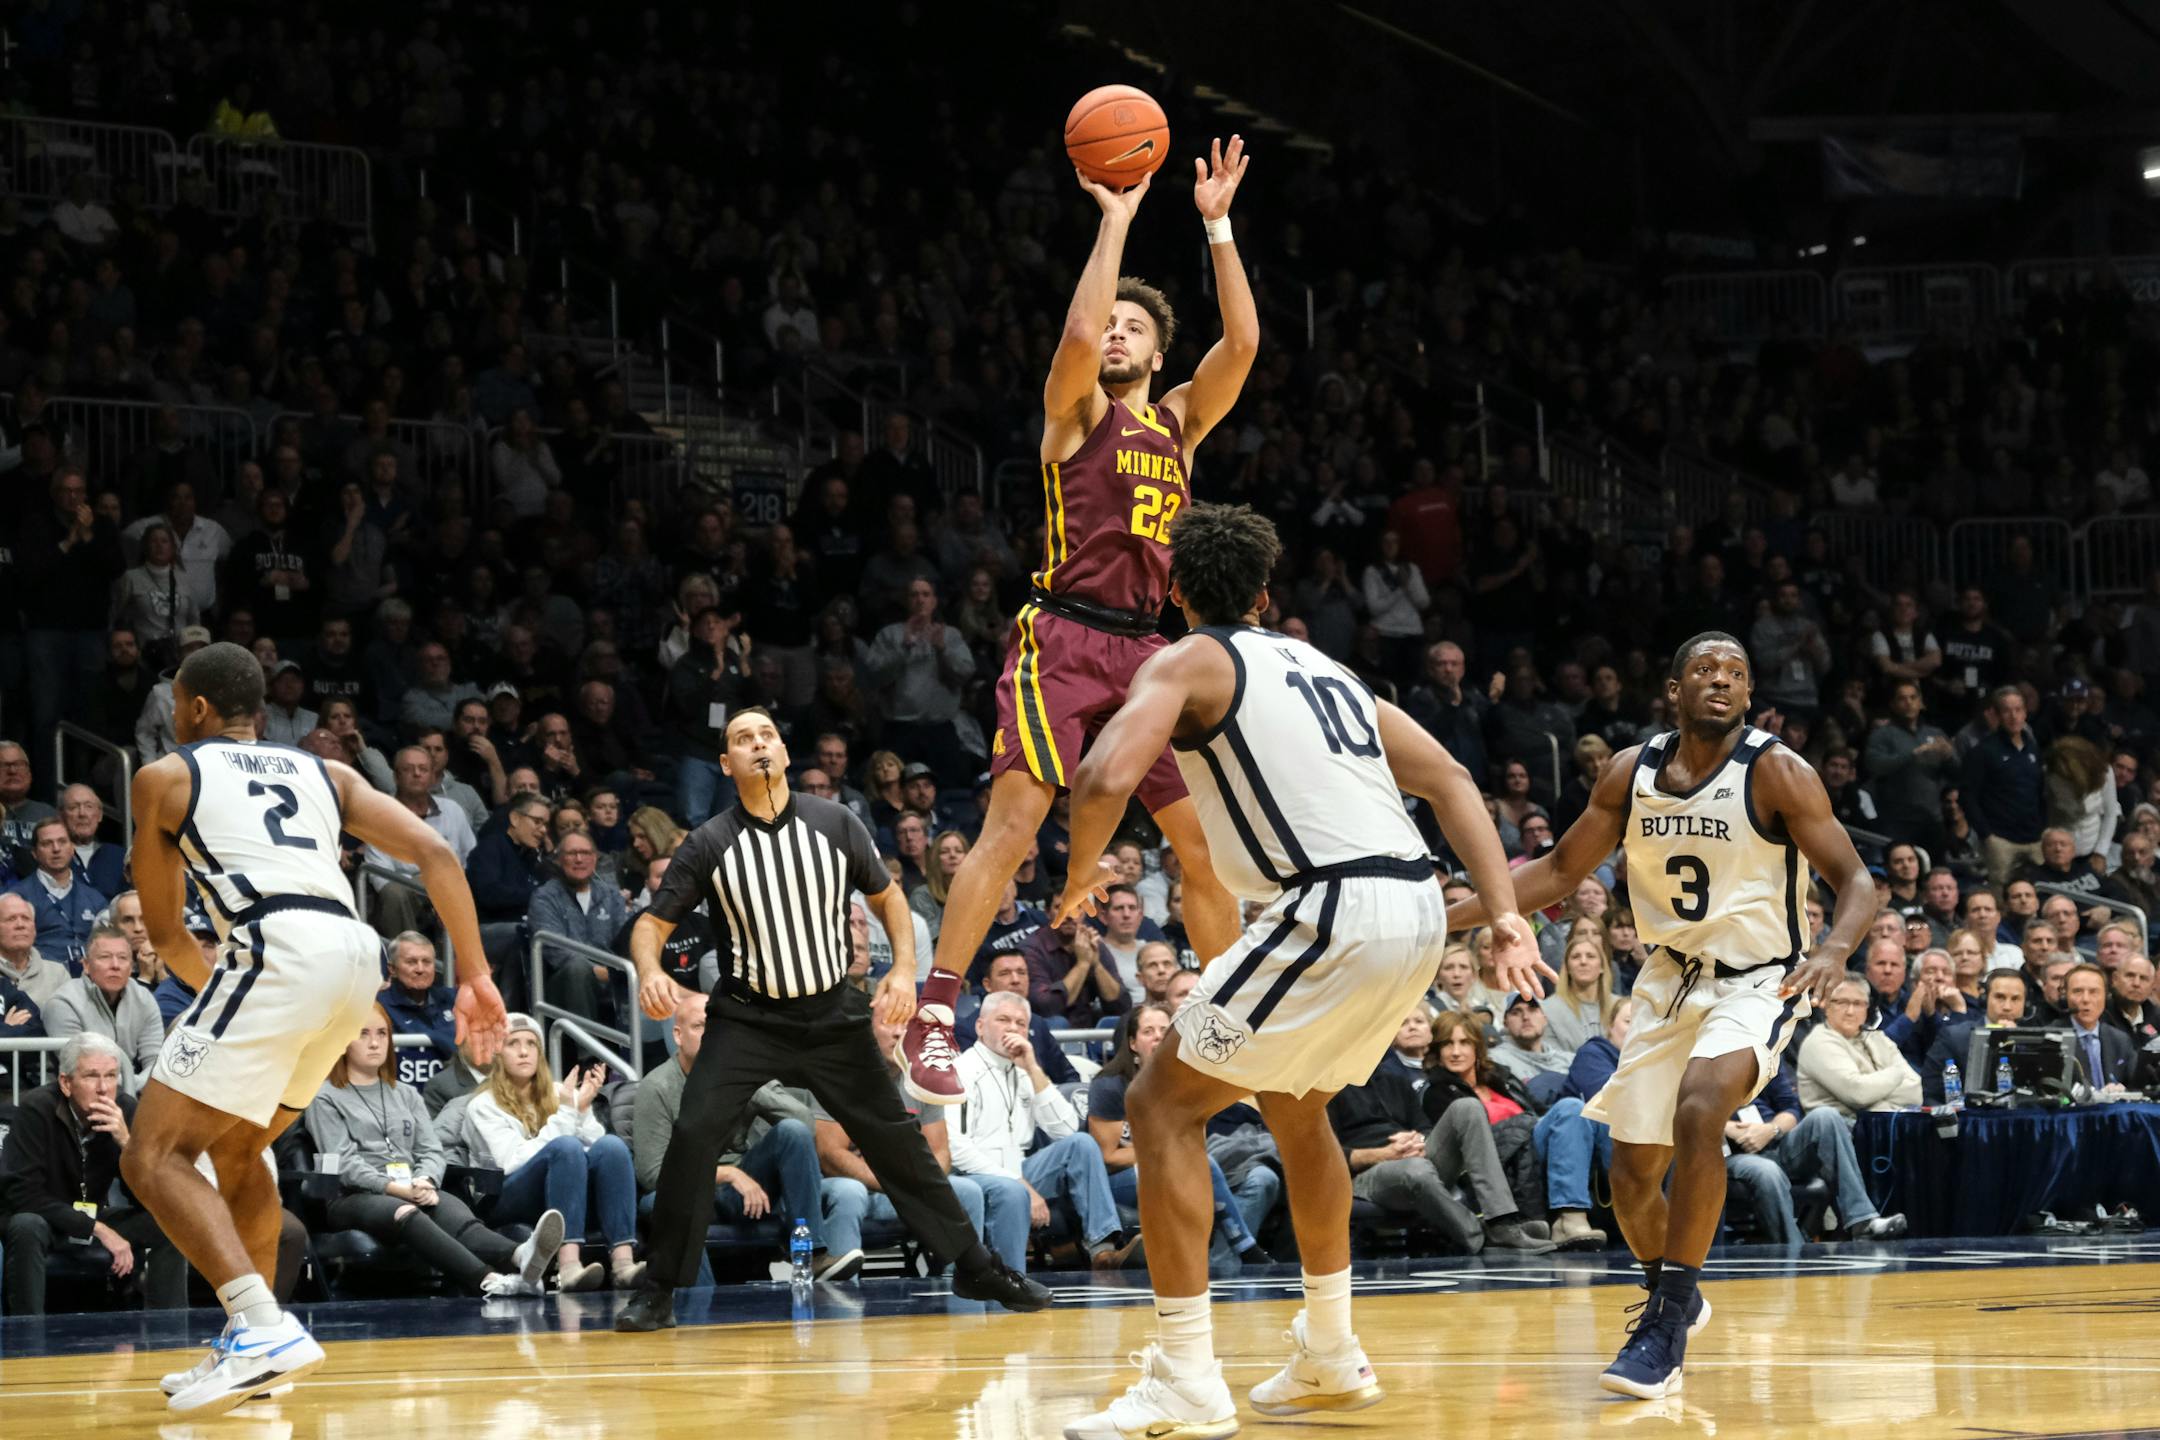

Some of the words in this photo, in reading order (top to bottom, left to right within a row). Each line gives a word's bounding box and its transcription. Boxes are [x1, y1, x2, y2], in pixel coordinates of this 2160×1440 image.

[740, 492, 780, 523] 218
[1131, 484, 1181, 545] 22
[313, 680, 360, 694] BUTLER
[1286, 672, 1382, 758] 10
[222, 751, 299, 776] THOMPSON
[249, 780, 318, 851] 2
[1641, 816, 1732, 842] BUTLER
[1666, 855, 1710, 922] 3
